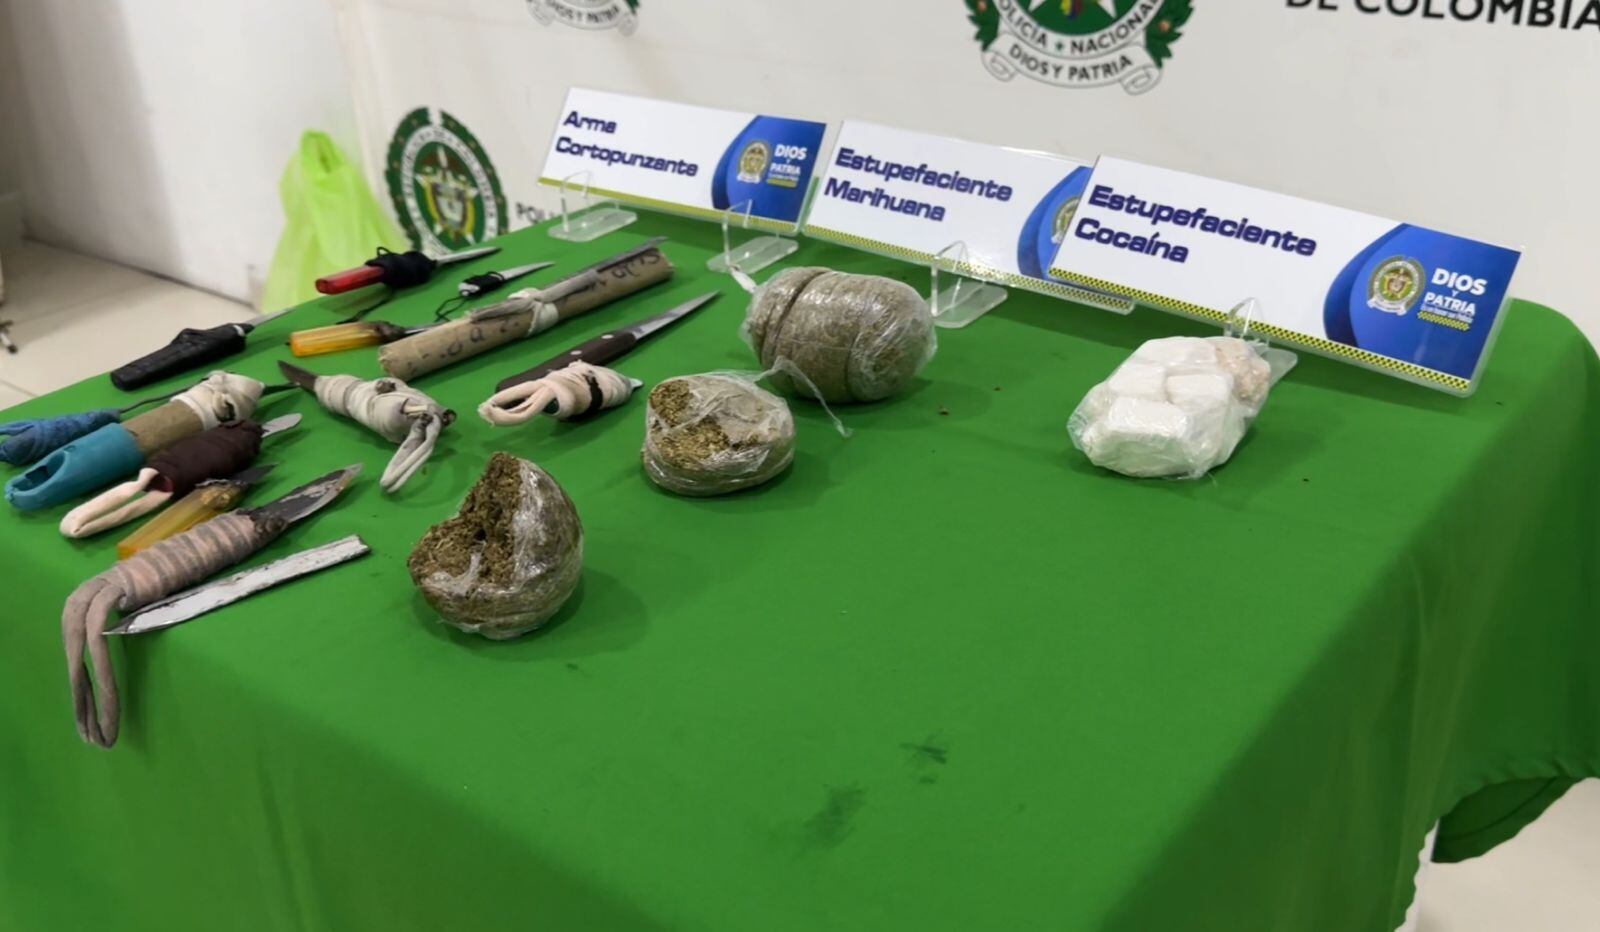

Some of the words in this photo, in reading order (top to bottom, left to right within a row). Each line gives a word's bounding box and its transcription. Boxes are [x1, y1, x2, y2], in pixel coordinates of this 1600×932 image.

[998, 0, 1048, 48] OLICIA
[1010, 43, 1049, 75] DIOS
[1052, 64, 1063, 79] Y
[1068, 54, 1133, 81] PATRIA
[563, 110, 617, 135] Arma
[555, 136, 699, 177] Cortopunzante
[770, 163, 801, 175] PATRIA
[774, 144, 807, 160] DIOS
[835, 147, 1013, 202] Estupefaciente
[824, 177, 946, 222] Marihuana
[1074, 217, 1189, 265] Cocaína
[1088, 185, 1317, 258] Estupefaciente
[1431, 268, 1488, 296] DIOS
[1424, 291, 1476, 316] PATRIA
